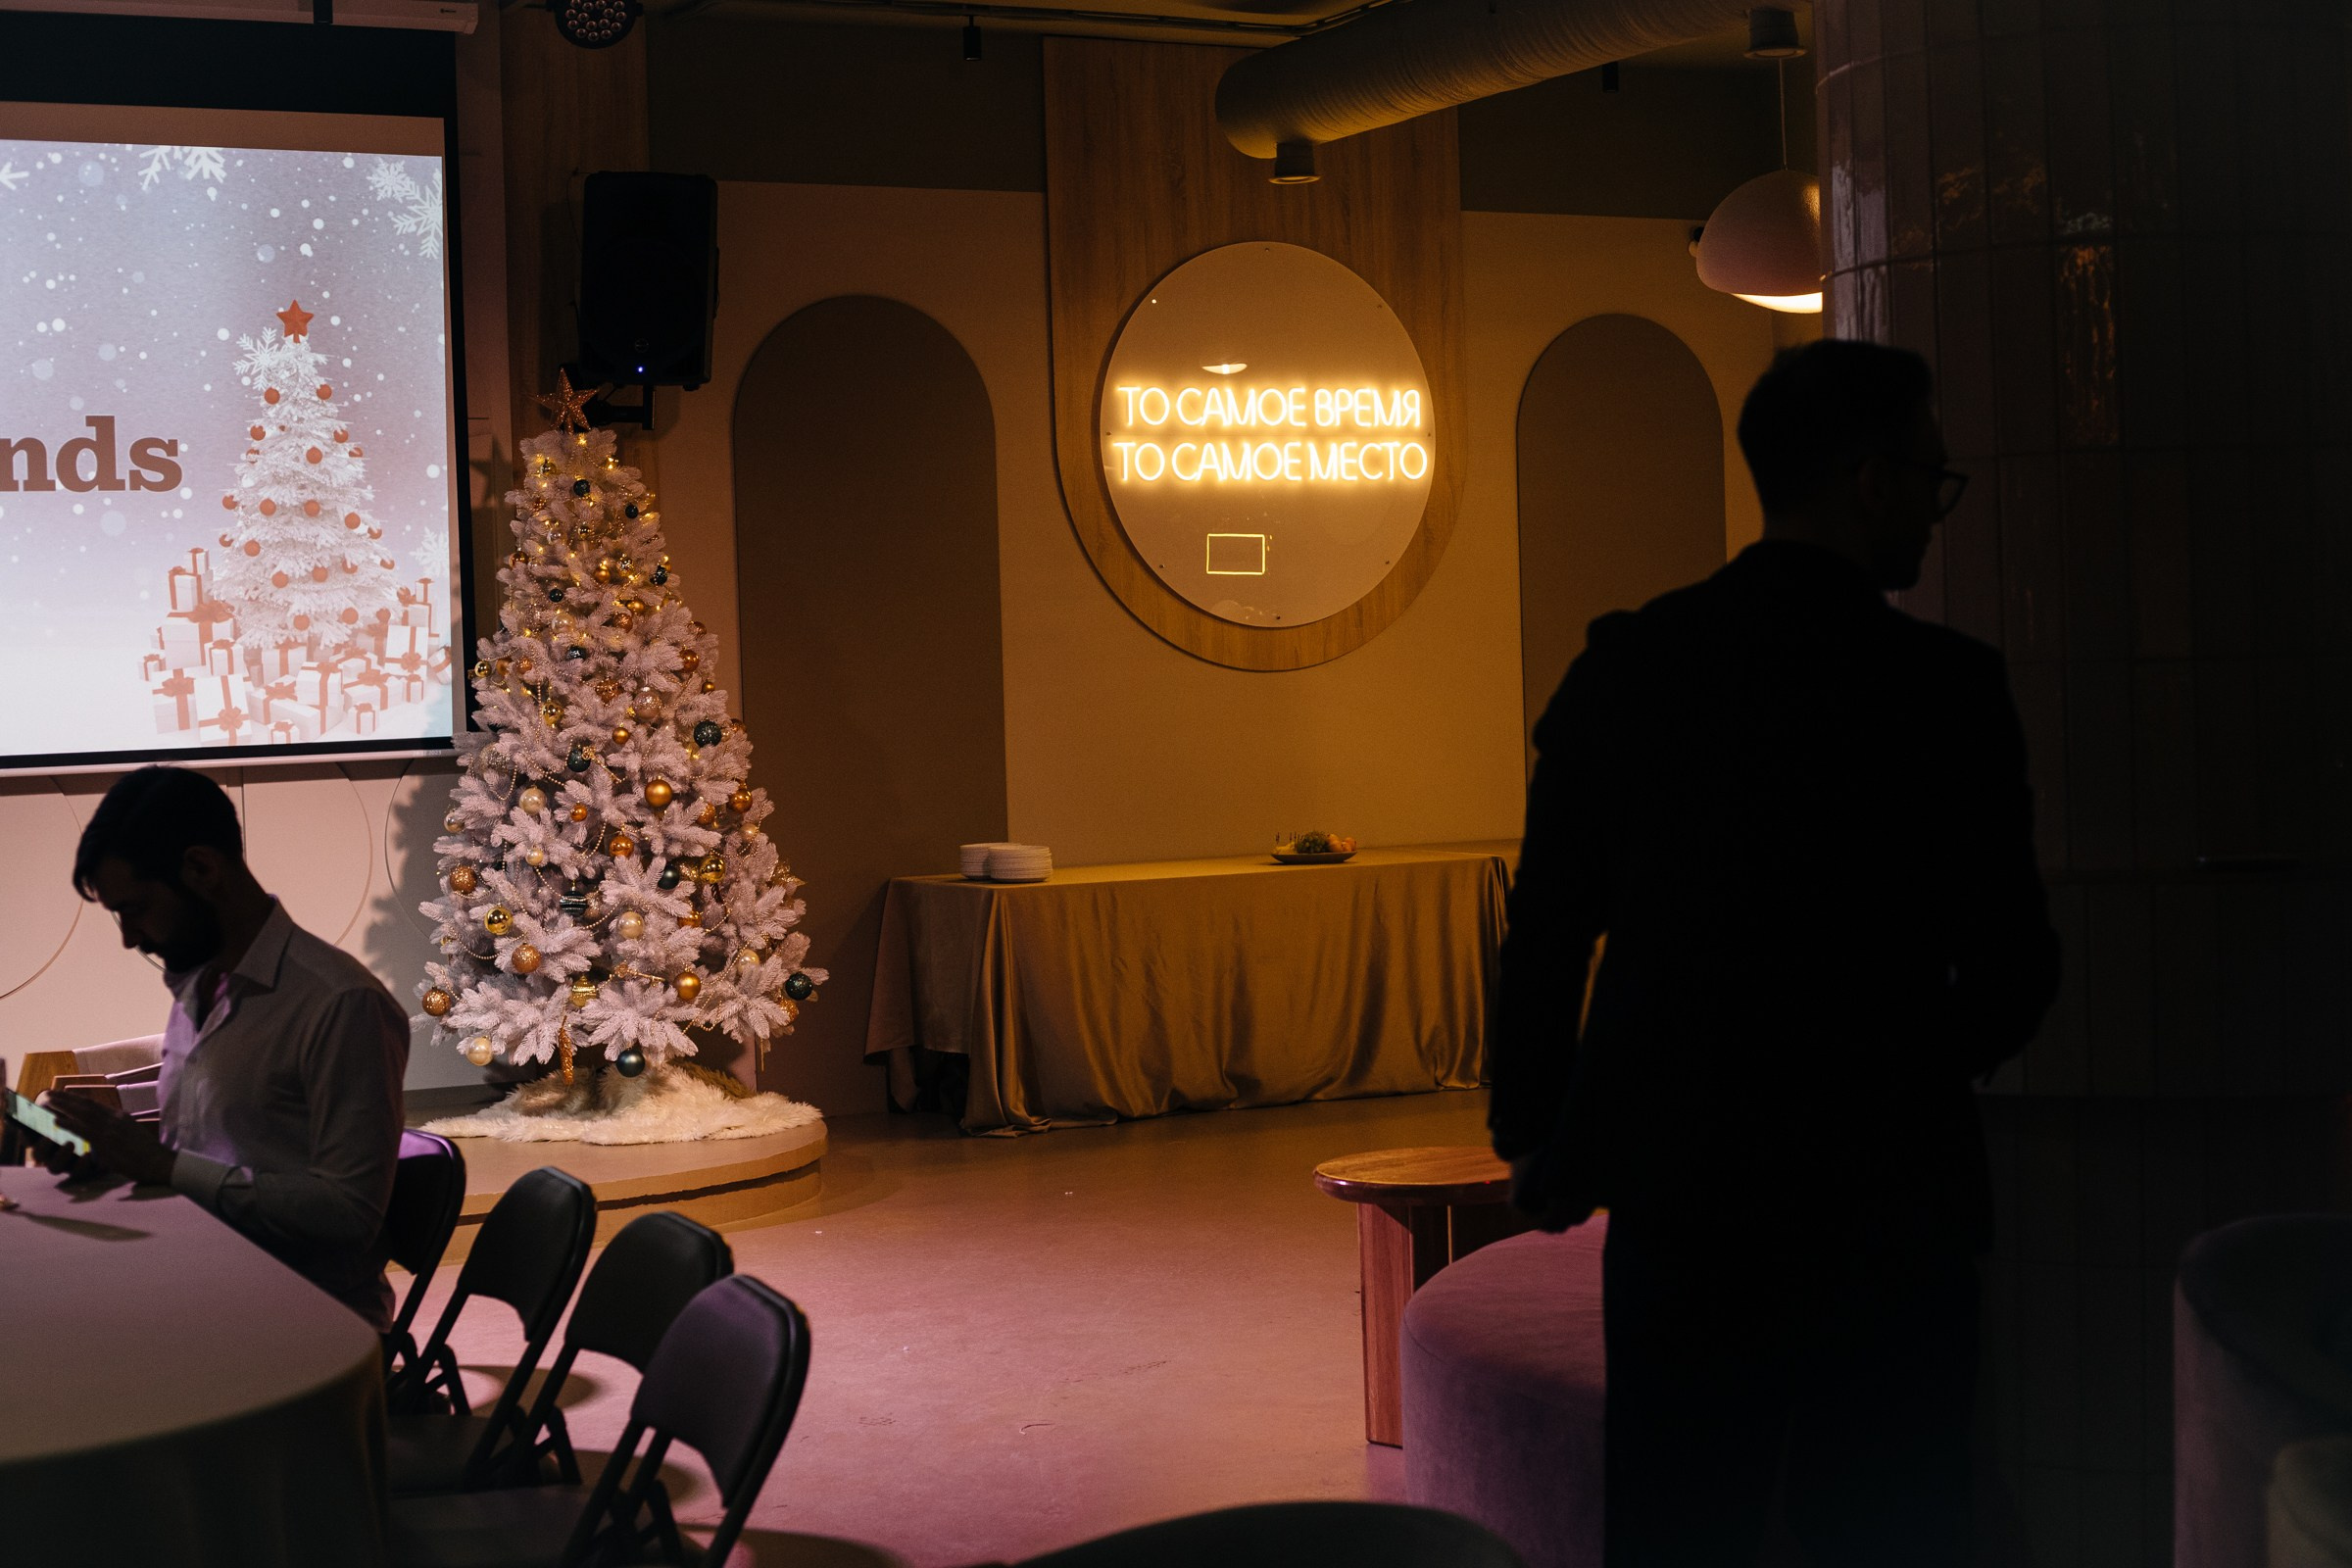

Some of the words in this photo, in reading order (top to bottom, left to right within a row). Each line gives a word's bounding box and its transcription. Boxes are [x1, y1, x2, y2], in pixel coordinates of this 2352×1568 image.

[1117, 386, 1170, 426] ТО
[1176, 387, 1307, 426] САМОЕ
[1314, 388, 1421, 426] ВРЕМЯ
[0, 415, 182, 492] nds
[1112, 441, 1165, 481] ТО
[1171, 441, 1301, 481] САМОЕ
[1308, 441, 1428, 480] МЕСТО
